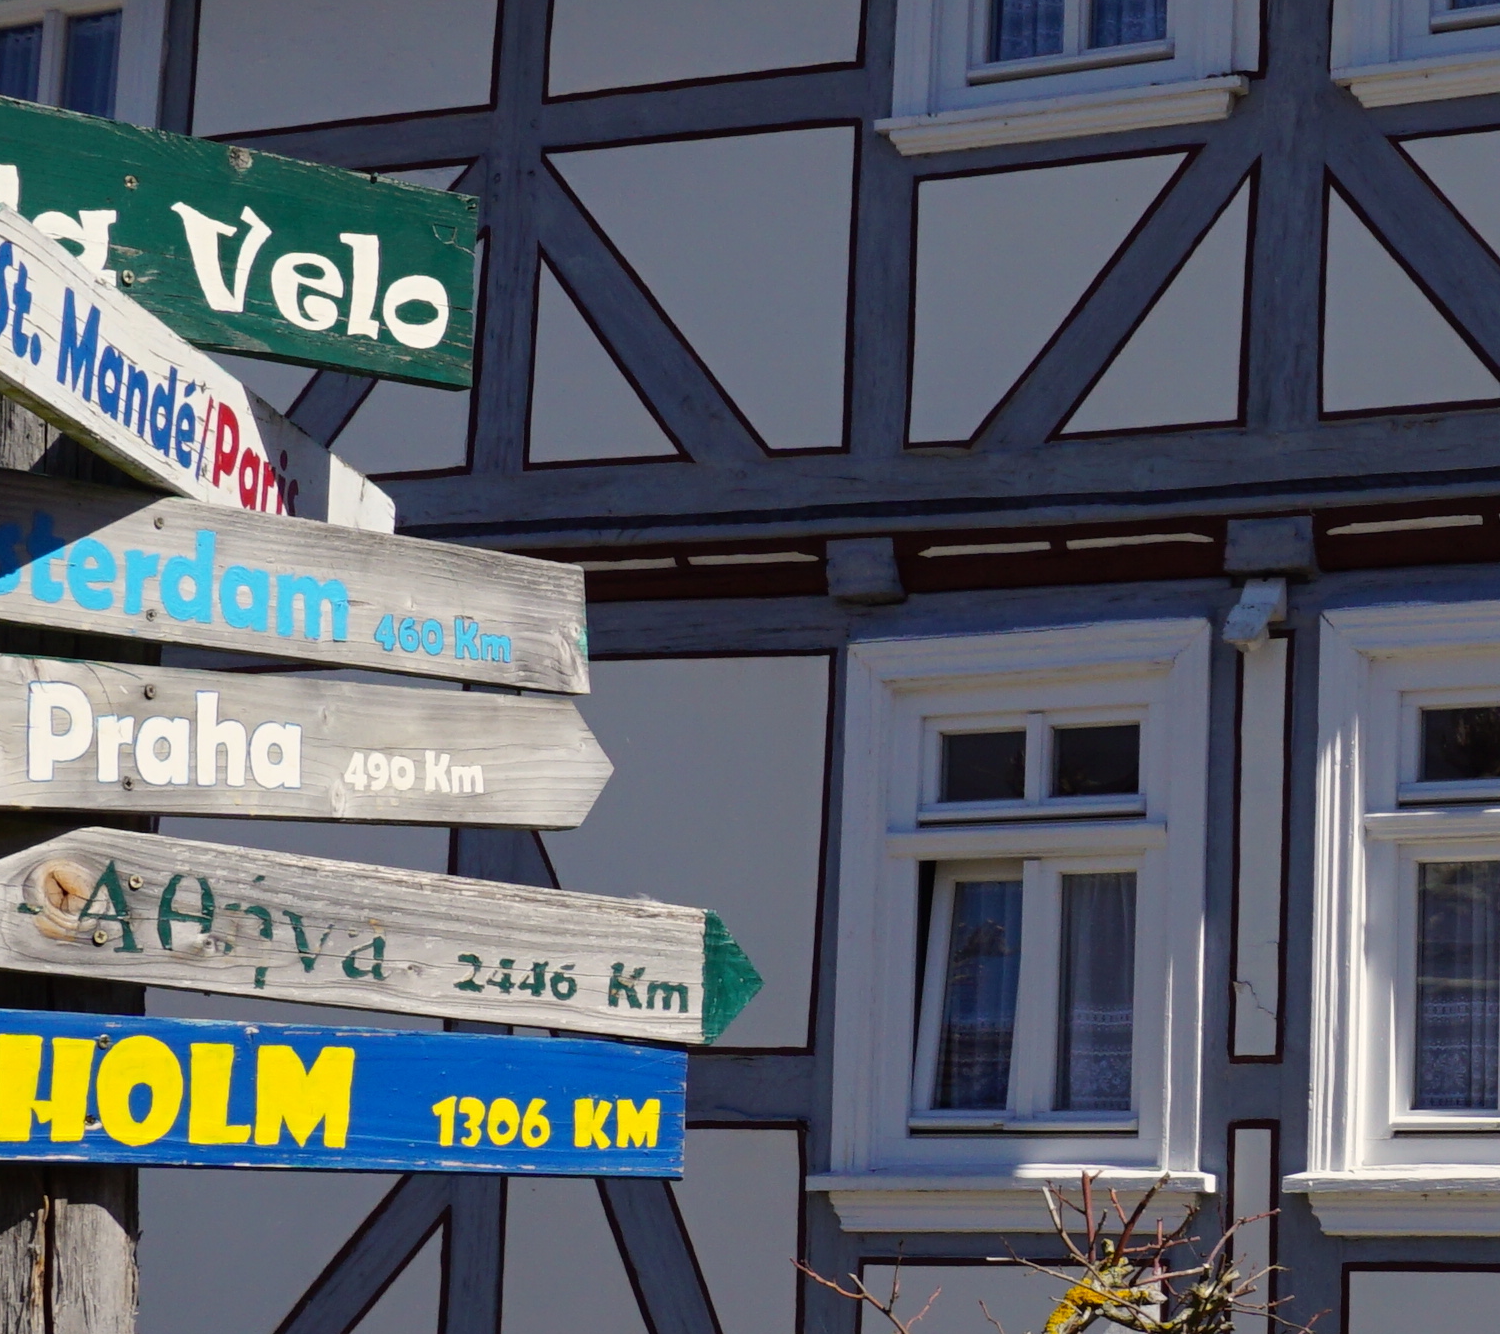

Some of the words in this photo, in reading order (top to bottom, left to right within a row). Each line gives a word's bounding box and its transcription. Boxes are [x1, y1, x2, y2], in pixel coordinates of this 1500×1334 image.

[171, 202, 449, 349] Velo
[374, 614, 444, 656] 460
[454, 617, 511, 663] Km
[27, 680, 302, 789] Praha
[344, 751, 415, 791] 490
[424, 750, 485, 794] Km
[453, 953, 577, 1001] 2446
[608, 962, 689, 1013] Km
[432, 1096, 550, 1148] 1306
[574, 1098, 660, 1149] KM
